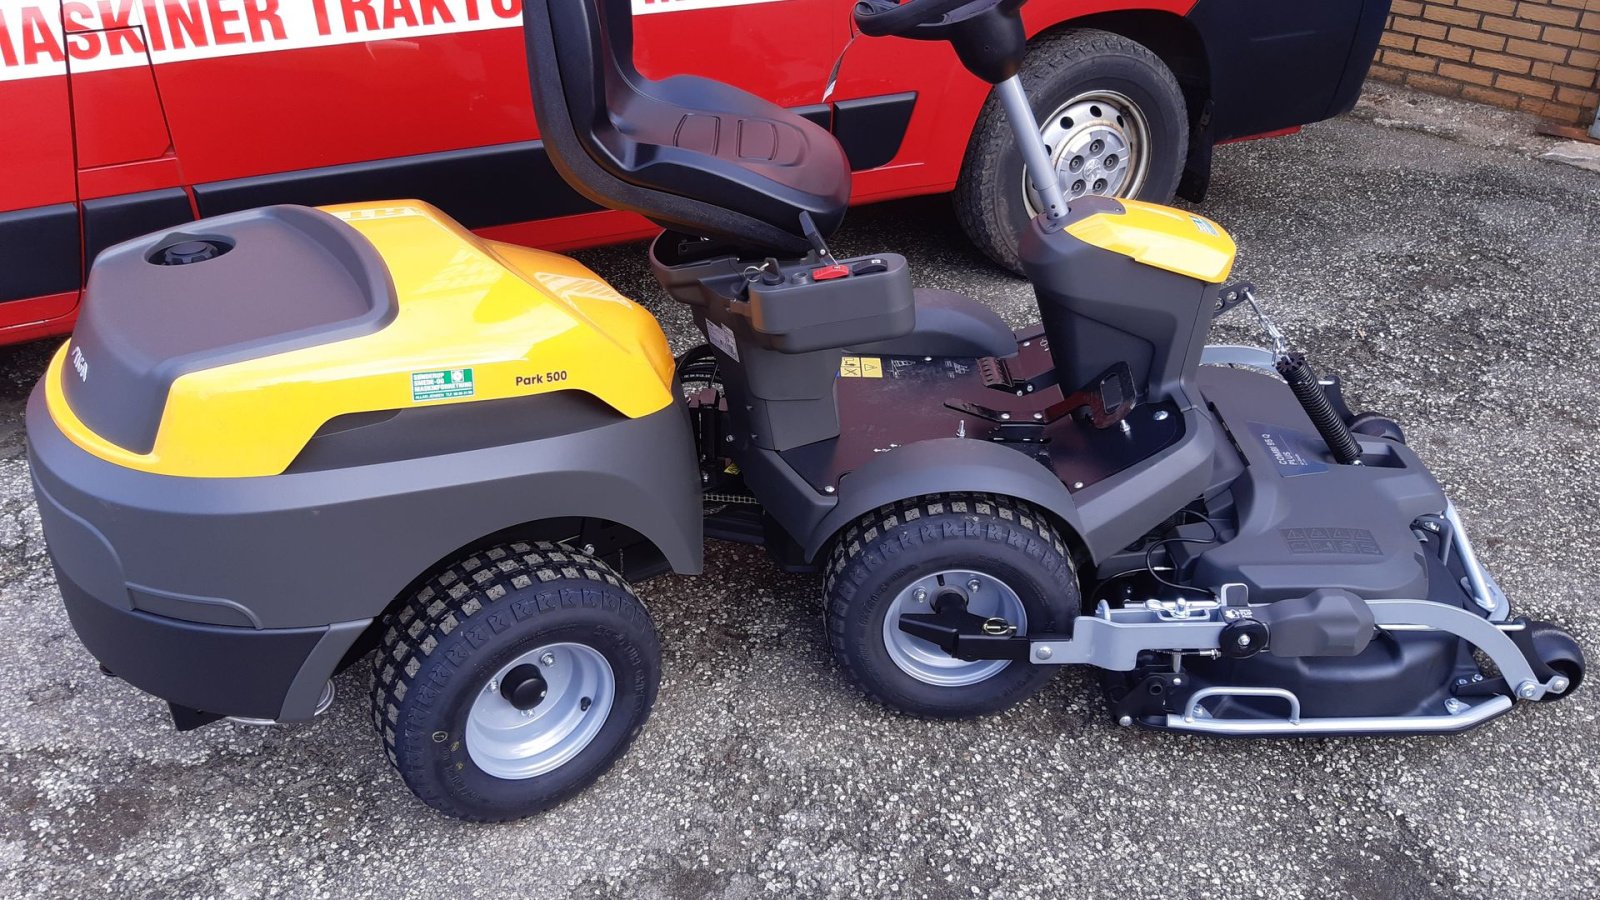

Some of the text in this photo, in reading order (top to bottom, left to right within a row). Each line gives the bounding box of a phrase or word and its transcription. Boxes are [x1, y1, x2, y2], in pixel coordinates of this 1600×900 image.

[515, 370, 567, 386] Park 500
[1270, 446, 1288, 465] COMBI
[1283, 451, 1298, 465] PLUS
